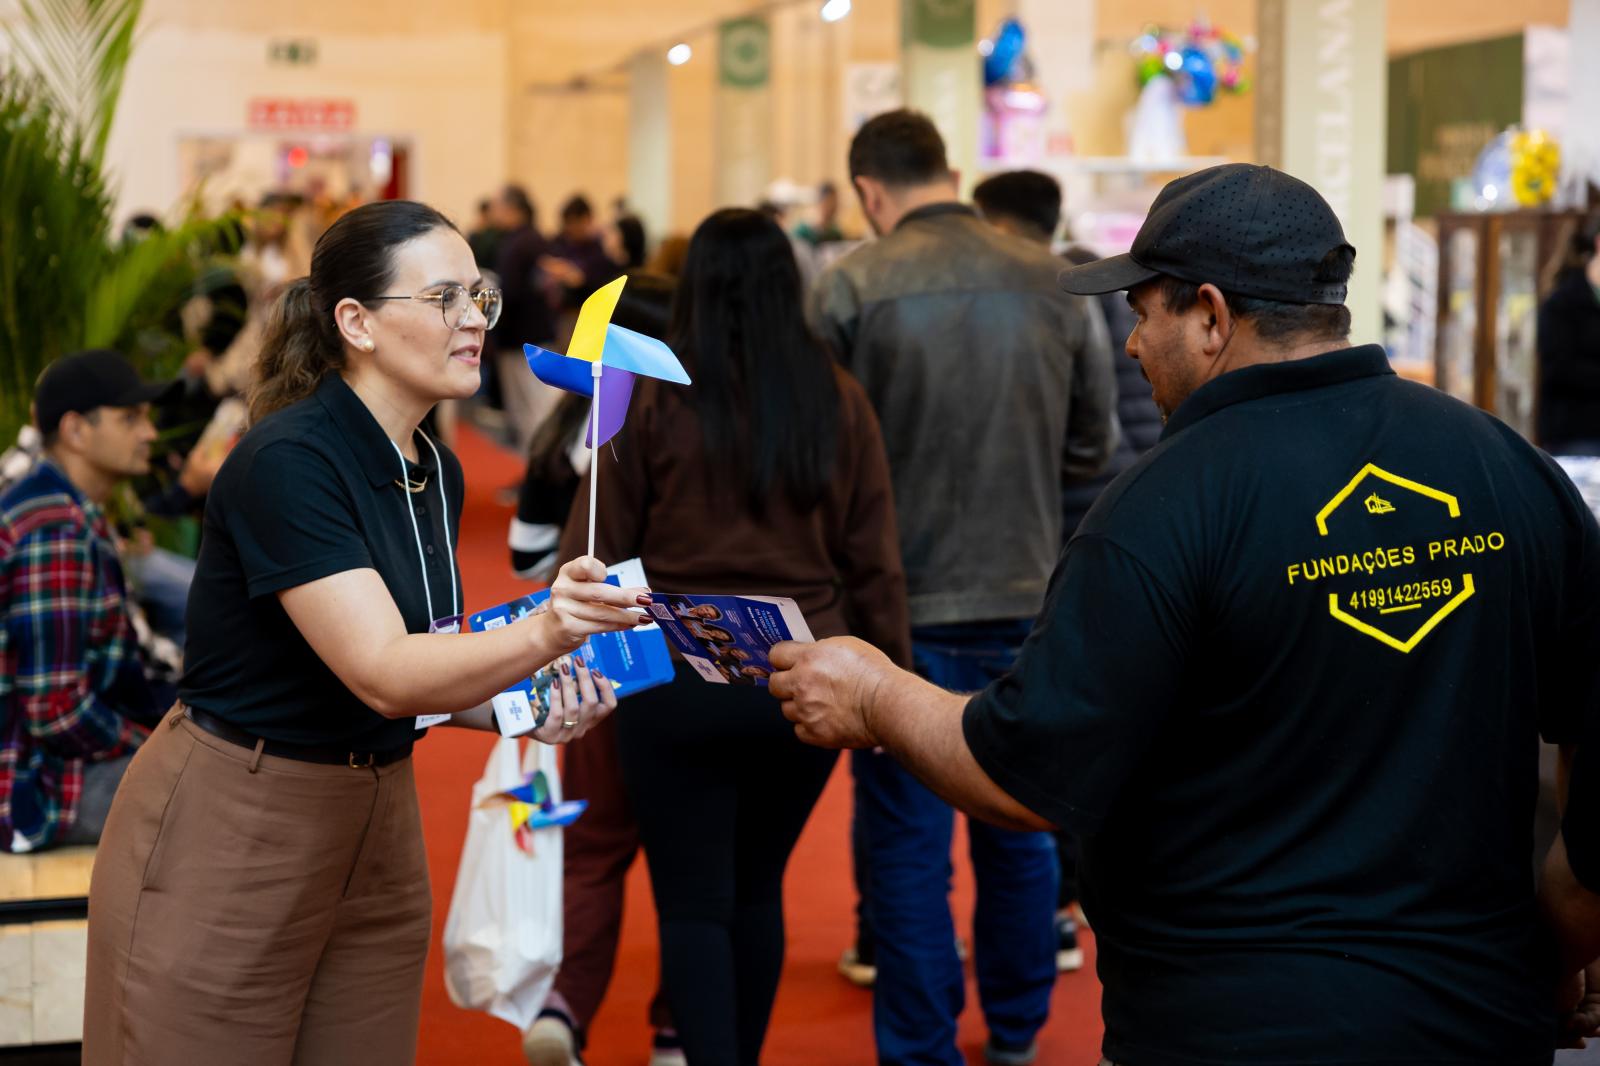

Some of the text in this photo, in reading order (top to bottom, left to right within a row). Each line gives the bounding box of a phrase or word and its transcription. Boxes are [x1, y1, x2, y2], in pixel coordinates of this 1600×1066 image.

[1287, 532, 1505, 585] FUNDAÇÕES PRADO
[1349, 578, 1453, 609] 41991422559
